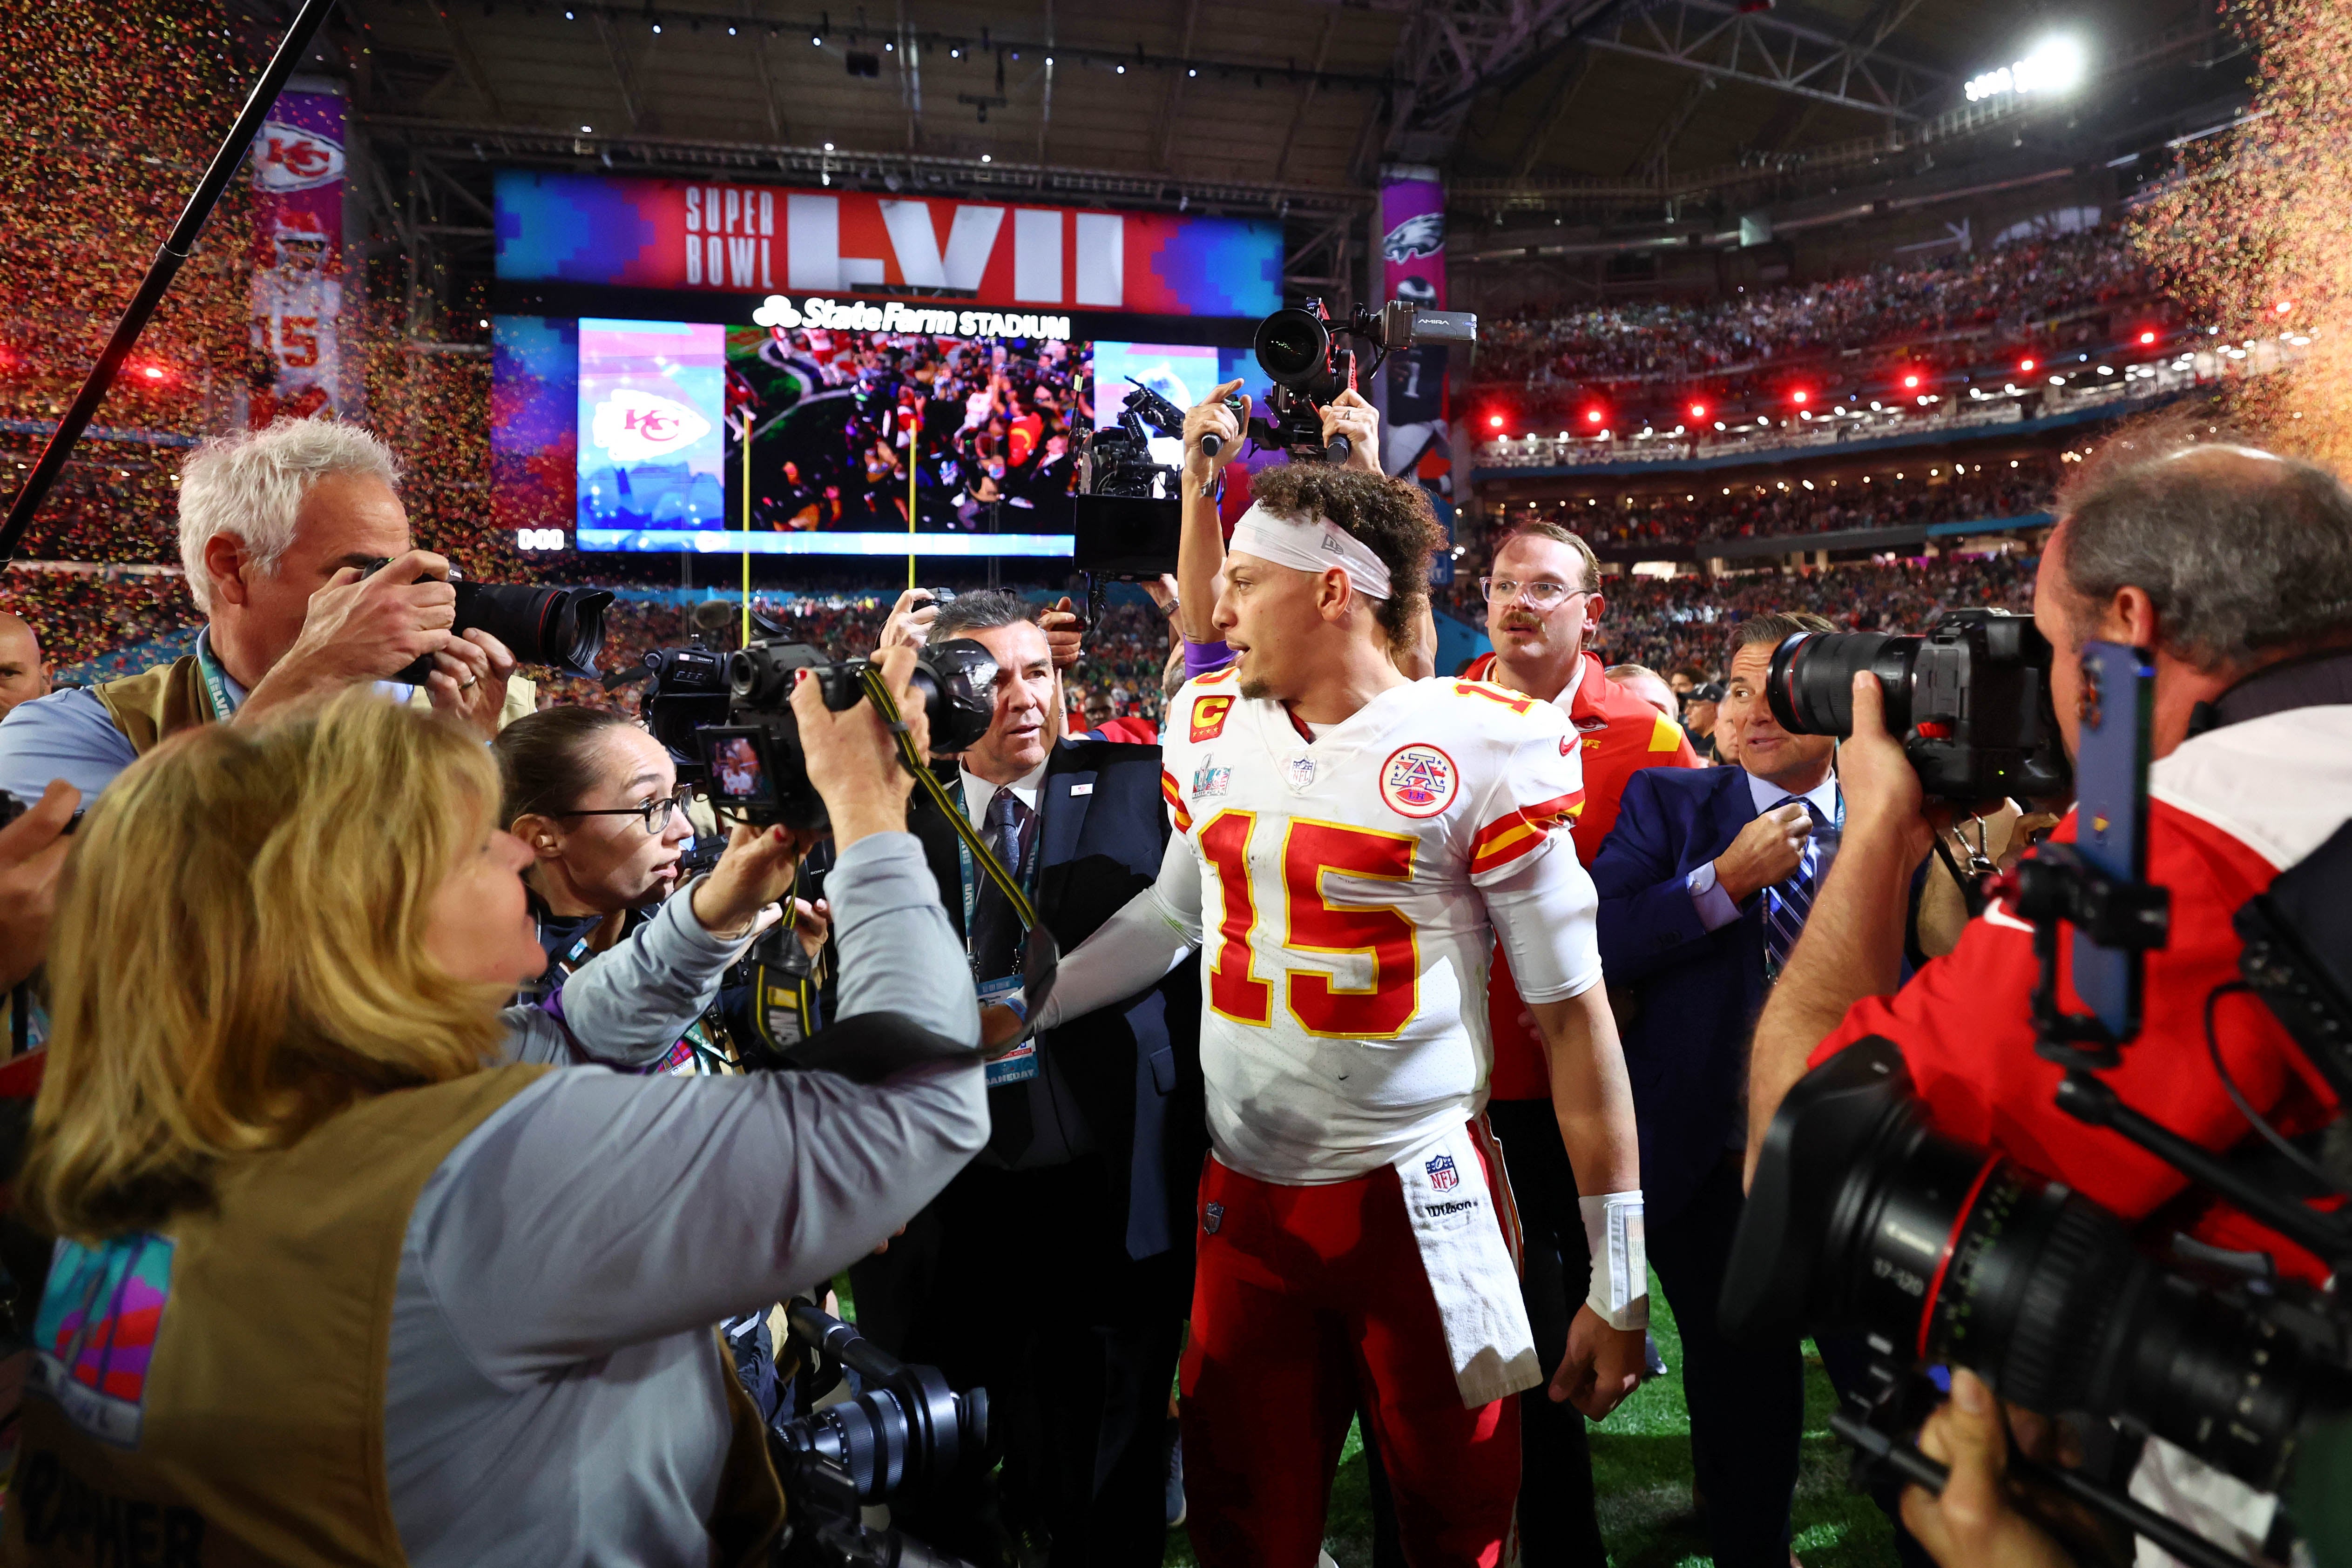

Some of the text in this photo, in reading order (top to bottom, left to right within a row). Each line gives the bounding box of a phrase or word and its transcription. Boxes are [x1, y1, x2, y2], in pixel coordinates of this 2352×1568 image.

[686, 186, 774, 236] SUPER
[686, 234, 773, 289] BOWL
[787, 193, 1123, 307] LVII
[959, 311, 1071, 340] STADIUM
[624, 409, 679, 442] KC
[1193, 698, 1229, 728] C
[1293, 770, 1309, 782] NFL
[1197, 808, 1420, 1040] 15
[1430, 1170, 1457, 1189] NFL
[1426, 1201, 1472, 1217] Wilson
